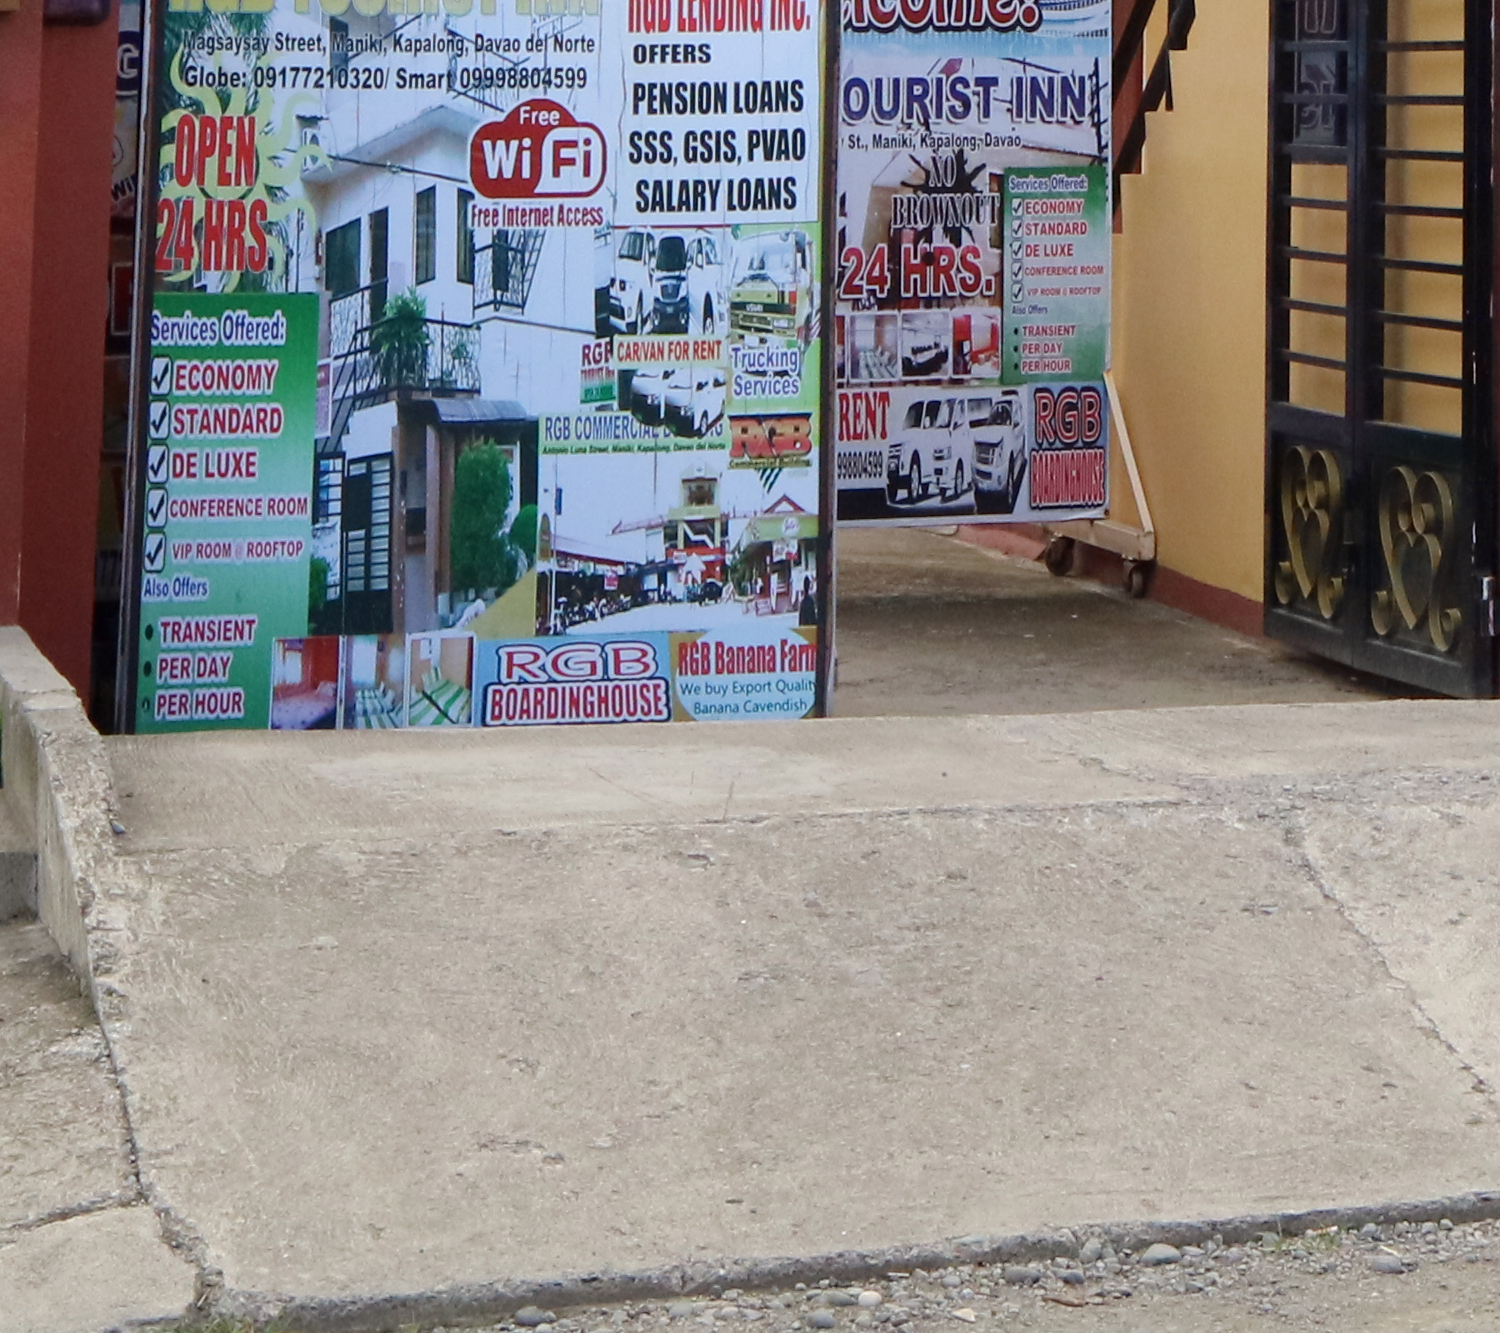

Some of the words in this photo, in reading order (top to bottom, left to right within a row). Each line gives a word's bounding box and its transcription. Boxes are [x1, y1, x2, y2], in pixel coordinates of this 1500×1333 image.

[183, 32, 270, 55] Magsaysay
[274, 32, 327, 54] Street,
[332, 32, 388, 55] Maniki,
[392, 33, 470, 57] Kapalong,
[474, 33, 521, 52] Davao
[525, 33, 548, 53] del
[553, 33, 596, 53] Norte
[632, 42, 712, 65] OFFERS
[183, 65, 247, 89] Globe:
[459, 66, 588, 90] 09998804599
[632, 81, 727, 115] PENSION
[733, 79, 805, 114] LOANS
[843, 76, 1000, 123] OURIST
[1011, 75, 1087, 122] INN
[518, 105, 561, 126] Free
[174, 113, 257, 188] OPEN
[627, 129, 679, 167] SSS,
[682, 128, 742, 167] GSIS,
[747, 127, 807, 162] PVAO
[872, 133, 917, 150] Maniki,
[984, 133, 1022, 148] Davao
[928, 154, 957, 187] NO
[1010, 175, 1049, 192] Services
[1051, 174, 1088, 191] Offered:
[634, 177, 722, 213] SALARY
[726, 175, 798, 212] LOANS
[471, 204, 499, 227] Free
[502, 203, 554, 228] Internet
[556, 203, 604, 227] Access
[891, 192, 1000, 229] BROWNOUT
[1024, 199, 1084, 215] ECONOMY
[154, 196, 195, 272] 24
[1024, 221, 1088, 236] STANDARD
[1024, 243, 1041, 258] DE
[1043, 242, 1074, 258] LUXE
[839, 244, 891, 298] 24
[901, 244, 996, 297] HRS.
[1024, 265, 1078, 277] CONFERENCE
[1080, 264, 1104, 276] ROOM
[1027, 287, 1039, 297] VIP
[1041, 287, 1061, 297] ROOM
[1069, 286, 1102, 297] ROOFTOP
[1011, 305, 1027, 316] Also
[1028, 304, 1048, 315] Offers
[150, 311, 218, 345] Services
[221, 309, 287, 344] Offered:
[1022, 324, 1076, 337] TRANSIENT
[668, 340, 690, 362] FOR
[693, 339, 723, 362] RENT
[731, 345, 800, 372] Trucking
[1021, 342, 1040, 355] PER
[1043, 341, 1063, 354] DAY
[173, 362, 278, 393] ECONOMY
[1021, 359, 1041, 373] PER
[1043, 358, 1071, 372] HOUR
[732, 374, 800, 397] Services
[172, 406, 283, 436] STANDARD
[545, 416, 571, 441] RGB
[838, 390, 891, 442] RENT
[1034, 387, 1102, 446] RGB
[171, 451, 198, 479] DE
[203, 450, 258, 479] LUXE
[1030, 448, 1105, 508] BOARDINGHOUSE
[169, 497, 263, 518] CONFERENCE
[266, 496, 309, 517] ROOM
[172, 541, 192, 561] VIP
[195, 541, 232, 560] ROOM
[246, 540, 304, 559] ROOFTOP
[143, 577, 170, 598] Also
[172, 576, 209, 598] Offers
[160, 619, 257, 644] TRANSIENT
[158, 655, 193, 681] PER
[195, 655, 232, 680] DAY
[501, 644, 654, 681] RGB
[678, 642, 710, 676] RGB
[715, 640, 776, 675] Banana
[680, 683, 701, 695] We
[705, 681, 728, 697] buy
[732, 681, 772, 696] Export
[156, 692, 190, 717] PER
[194, 690, 244, 716] HOUR
[490, 682, 664, 722] BOARDINGHOUSE
[694, 701, 741, 715] Banana
[744, 698, 807, 714] Cavendish
